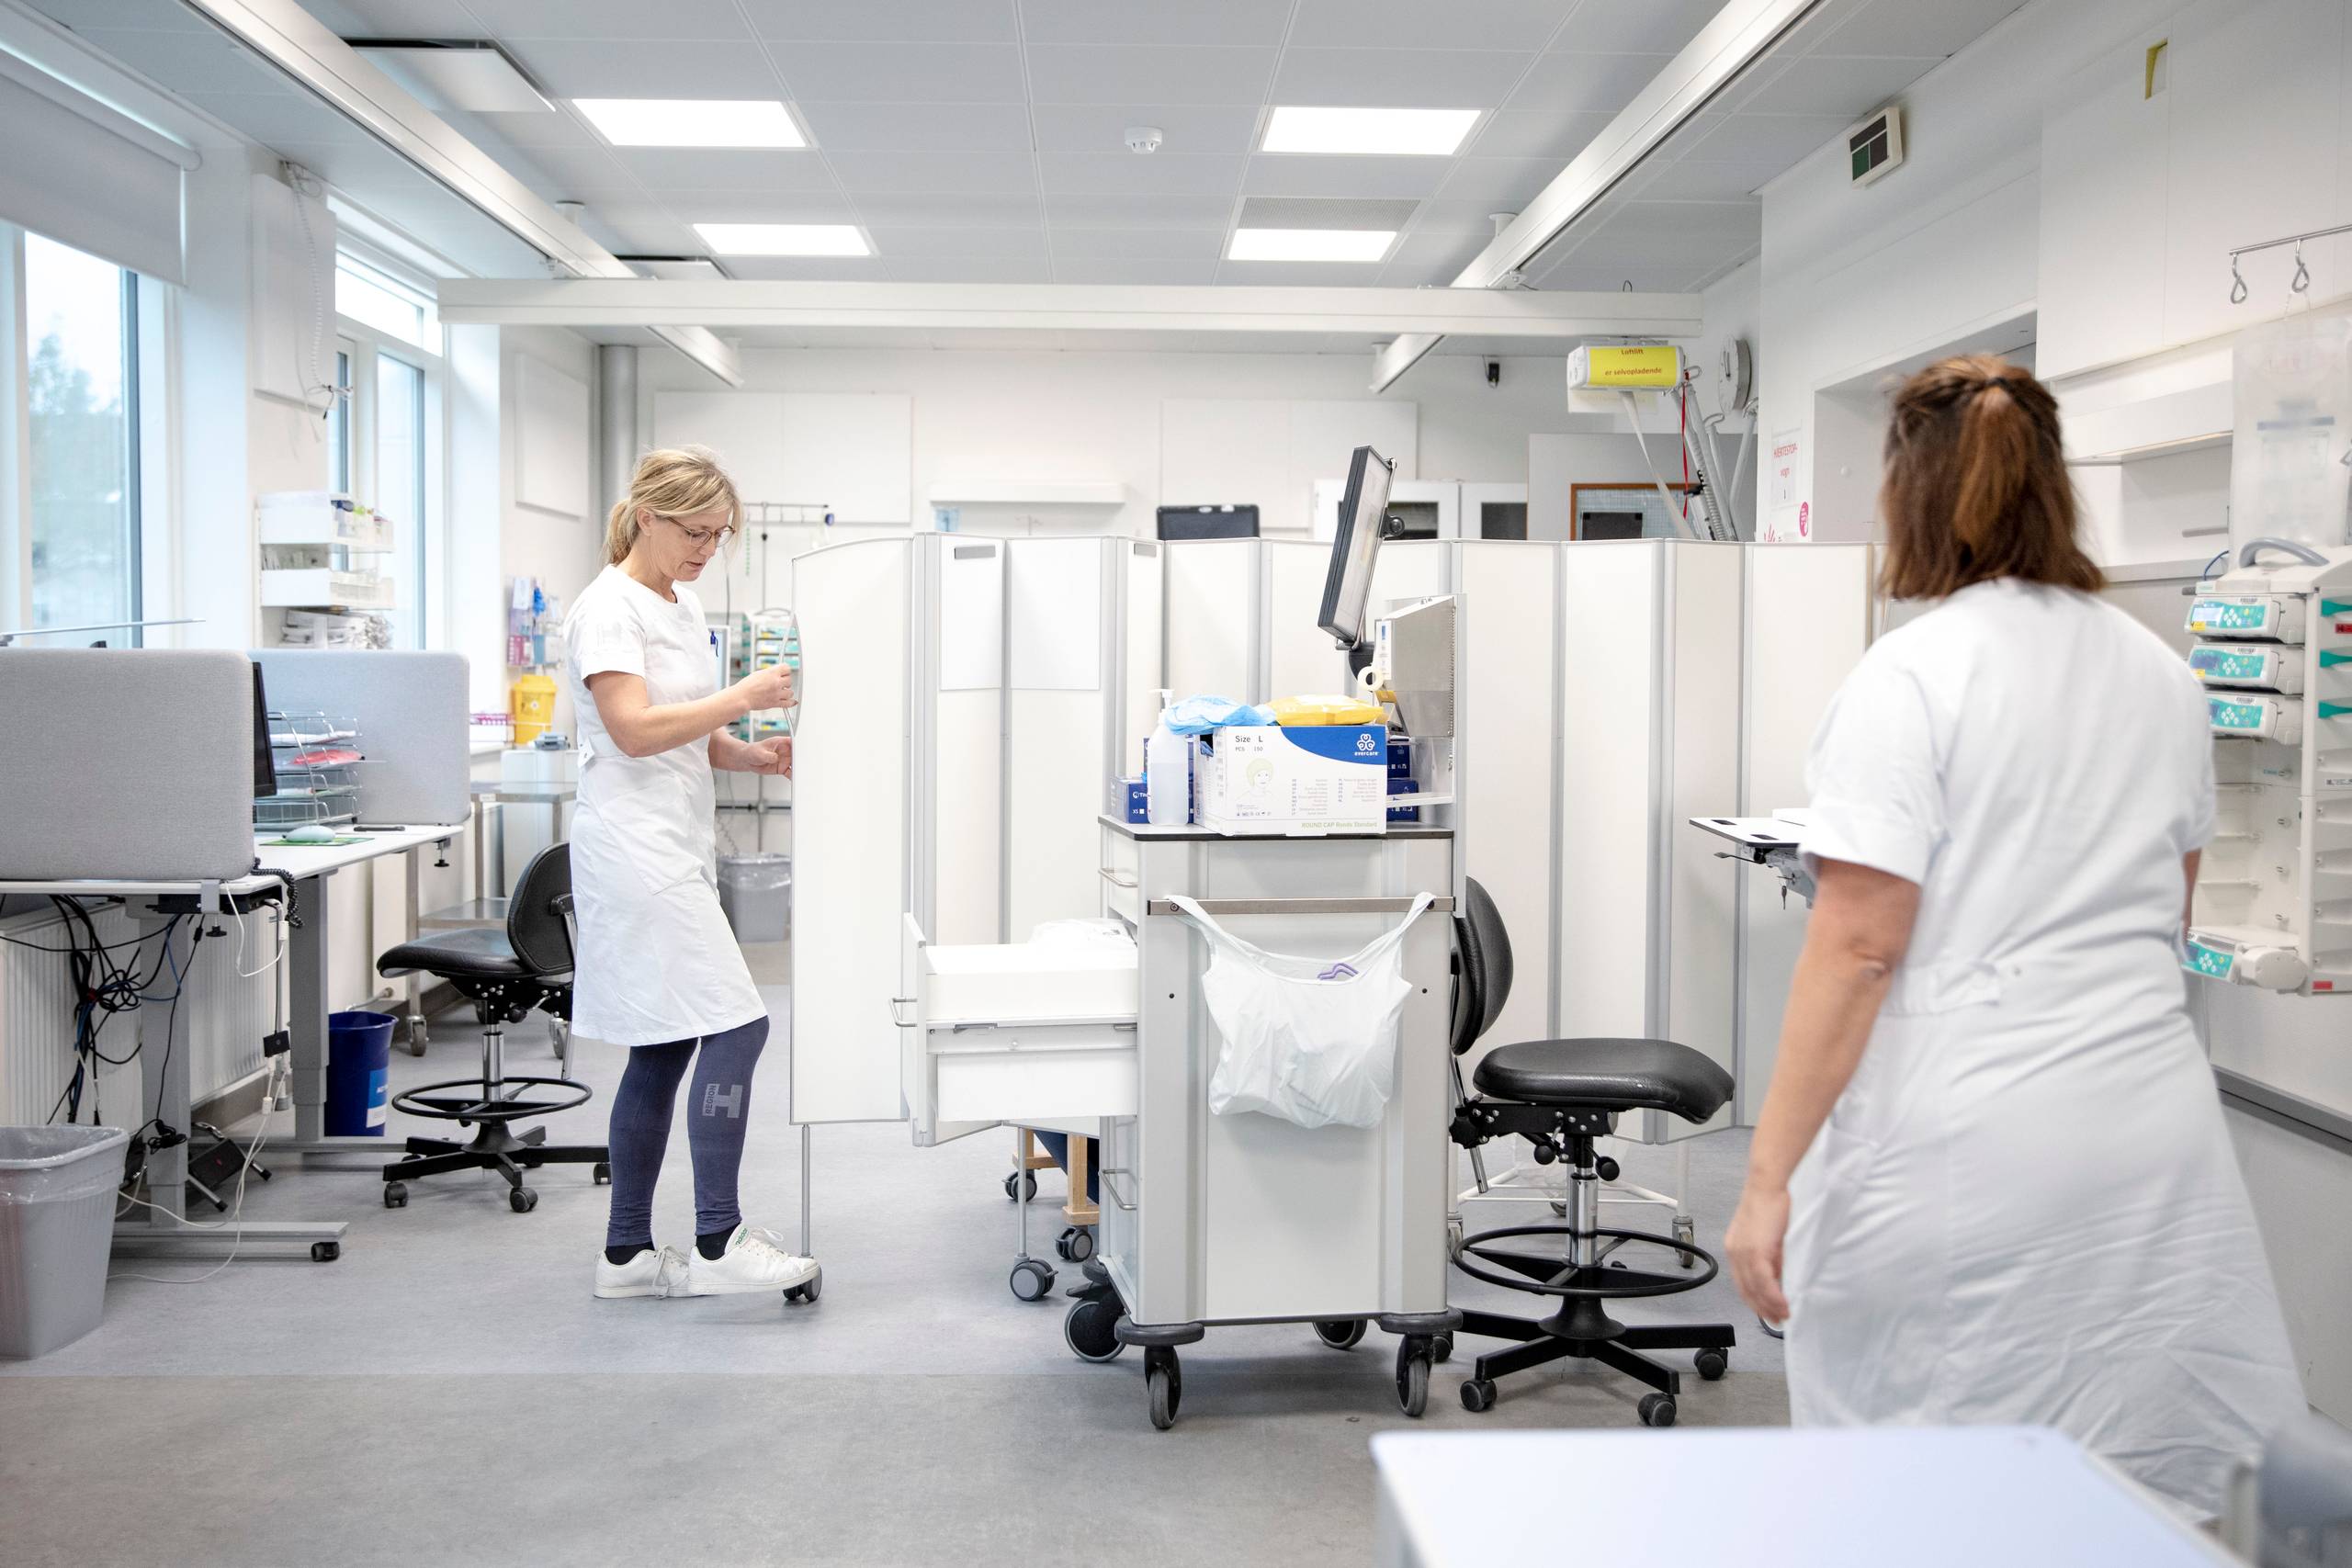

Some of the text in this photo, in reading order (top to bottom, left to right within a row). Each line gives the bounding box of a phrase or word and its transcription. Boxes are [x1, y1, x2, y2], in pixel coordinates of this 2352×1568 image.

[1235, 735, 1263, 743] Size L
[705, 1085, 717, 1114] REGION
